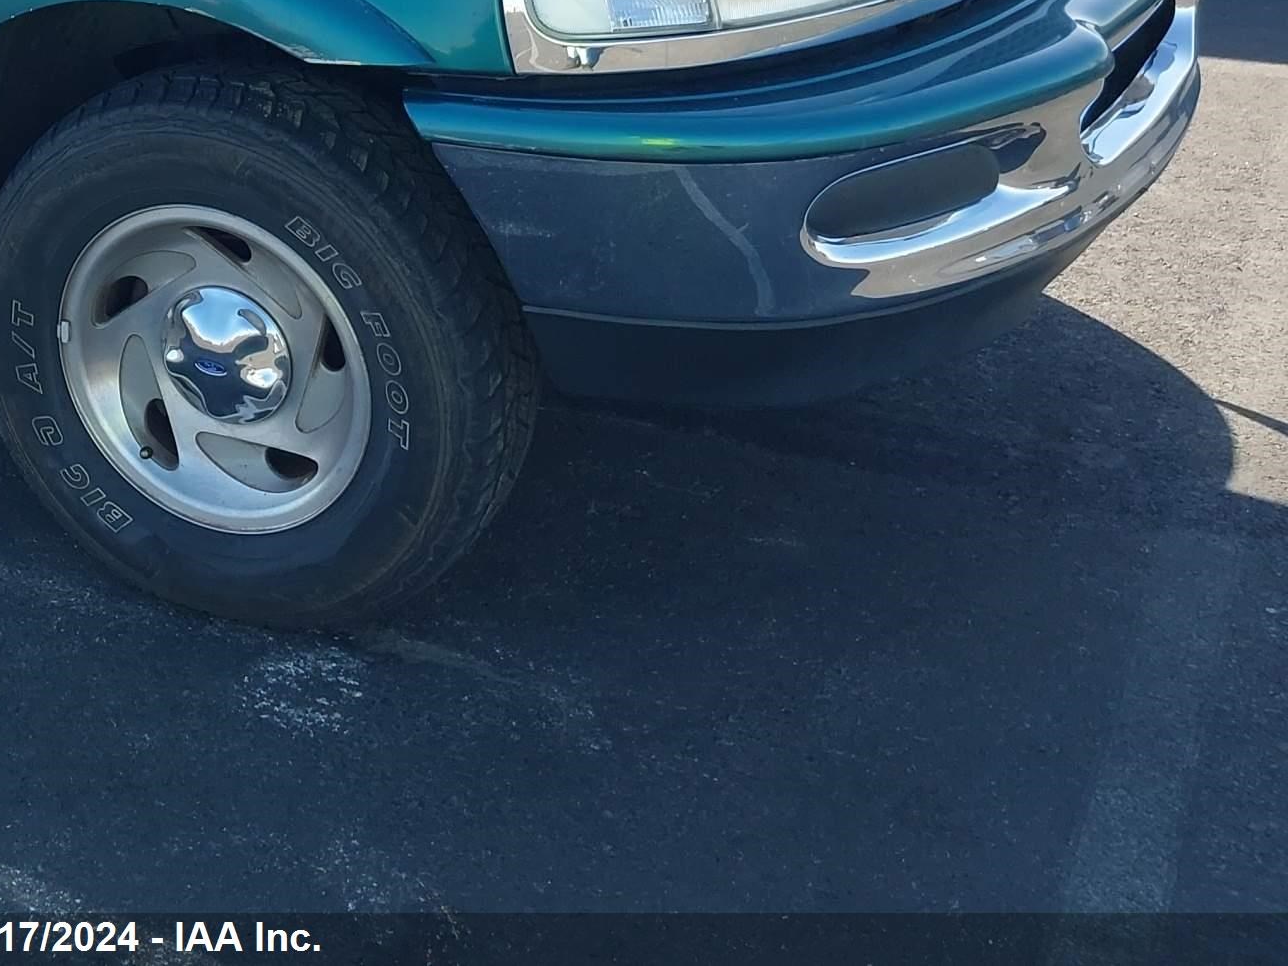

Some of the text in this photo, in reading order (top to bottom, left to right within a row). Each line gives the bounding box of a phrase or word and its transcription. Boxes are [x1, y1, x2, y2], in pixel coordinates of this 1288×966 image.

[11, 299, 43, 395] A/T
[284, 216, 411, 451] BIG FOOT
[59, 463, 134, 534] BIG
